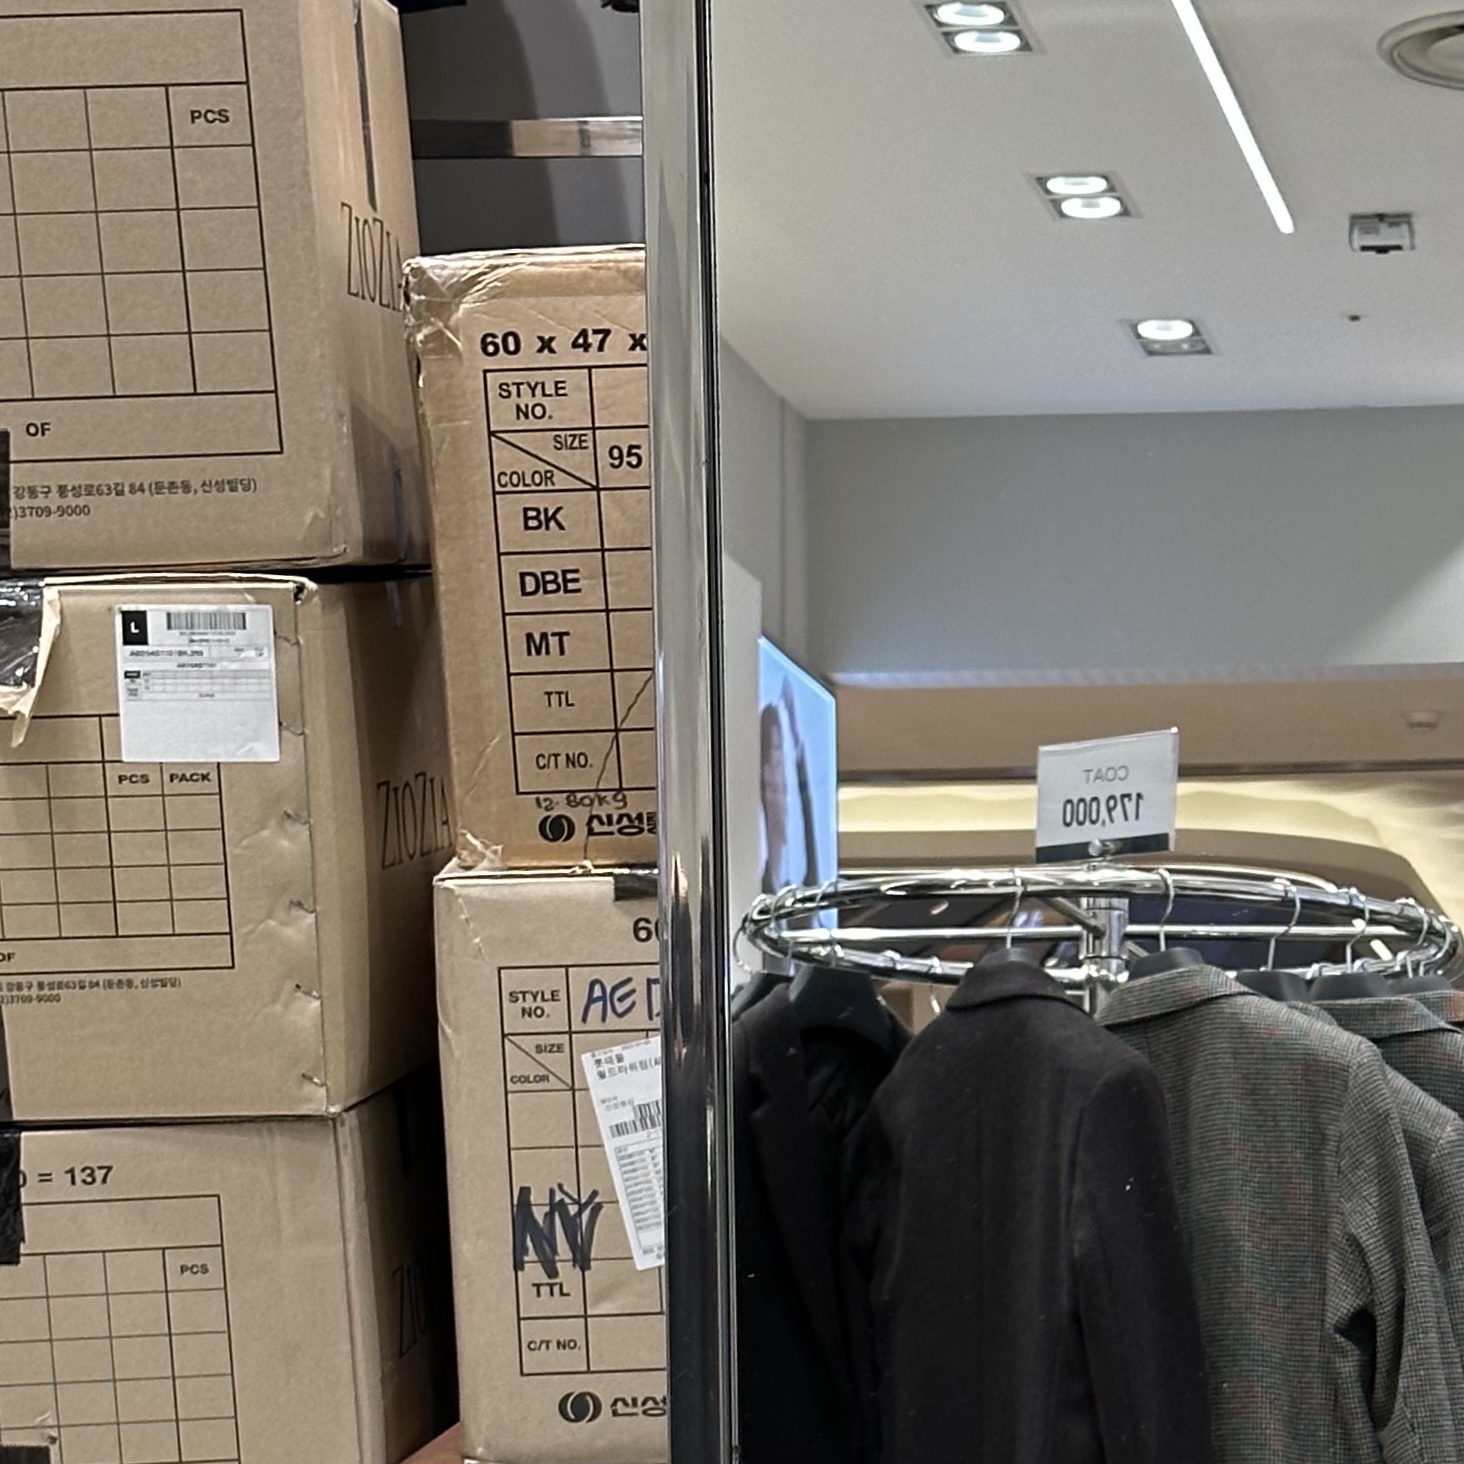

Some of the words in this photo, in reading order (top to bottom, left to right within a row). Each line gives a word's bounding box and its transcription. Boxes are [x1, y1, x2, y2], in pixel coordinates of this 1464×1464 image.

[190, 109, 230, 125] PCS
[480, 330, 521, 357] 60
[571, 328, 612, 353] 47
[498, 380, 568, 399] STYLE
[515, 403, 553, 420] NO.
[25, 422, 51, 437] OF
[553, 433, 590, 451] SIZE
[608, 444, 643, 469] 95
[497, 470, 556, 488] COLOR
[128, 481, 146, 495] 84
[522, 506, 566, 531] BK
[519, 568, 582, 597] DBE
[130, 621, 140, 633] L
[525, 631, 571, 657] MT
[544, 691, 575, 707] TTL
[535, 753, 560, 770] C/T
[565, 752, 593, 769] NO.
[117, 774, 150, 785] PCS
[169, 772, 213, 784] PACK
[377, 771, 453, 870] ZIOZIA
[509, 990, 561, 1003] STYLE
[521, 1007, 550, 1018] NO.
[535, 1043, 565, 1054] SIZE
[509, 1074, 550, 1085] COLOR
[64, 1165, 113, 1186] 137
[180, 1263, 209, 1275] PCS
[532, 1282, 571, 1297] TTL
[527, 1340, 551, 1351] C/T
[556, 1339, 581, 1350] NO.
